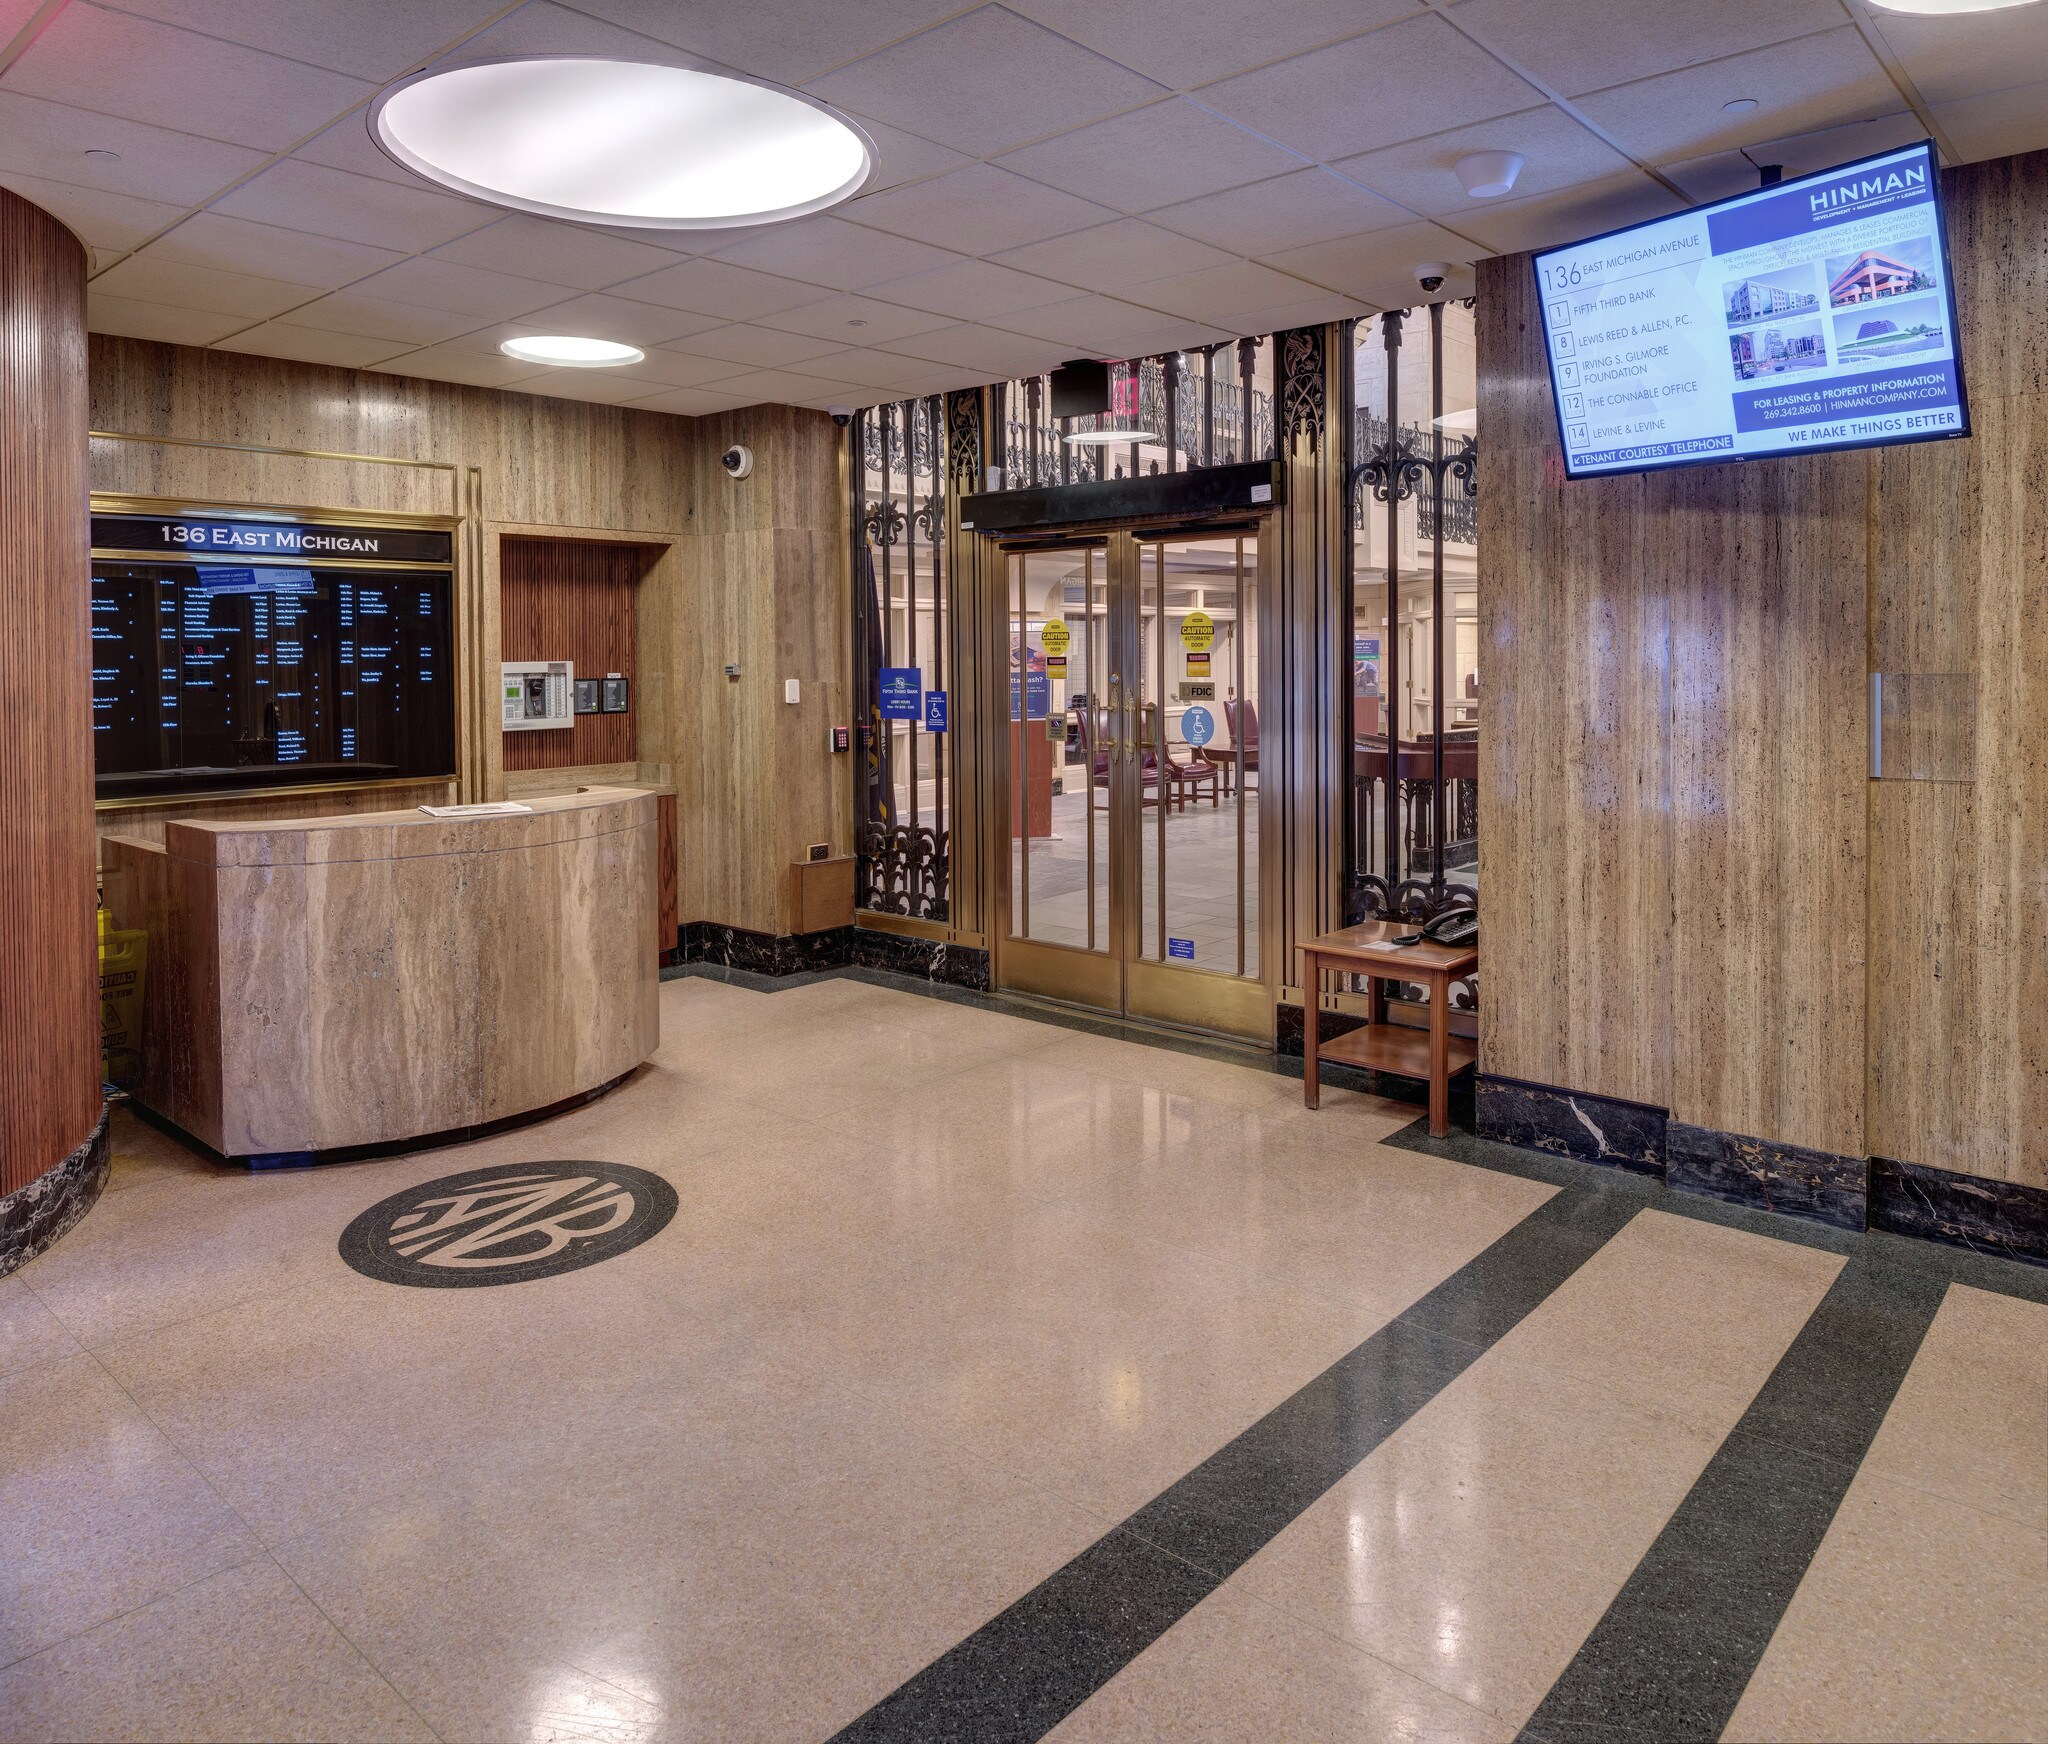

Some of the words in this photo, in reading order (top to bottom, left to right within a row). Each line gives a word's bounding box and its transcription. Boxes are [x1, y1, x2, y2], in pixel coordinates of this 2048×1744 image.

[1809, 165, 1926, 212] HINMAN
[1813, 208, 1851, 222] DEVELOPMENT
[1856, 197, 1895, 211] MANAGEMENT
[1901, 188, 1926, 199] LEASING
[1723, 256, 1733, 265] THE
[1733, 250, 1758, 262] HINMAN
[1759, 243, 1788, 256] COMPANY
[1821, 227, 1852, 240] MANAGES
[1859, 220, 1881, 232] LEASES
[1882, 208, 1929, 225] COMMERCIAL
[1727, 262, 1745, 272] SPACE
[1788, 248, 1800, 256] THE
[1800, 241, 1828, 254] MIDWEST
[1829, 238, 1846, 248] WITH
[1852, 230, 1878, 241] DIVERSE
[1879, 220, 1917, 234] PORTFOLIO
[1786, 256, 1805, 266] RETAIL
[1853, 237, 1892, 250] RESIDENTIAL
[1892, 226, 1929, 241] BUILDINGS
[1544, 262, 1582, 291] 136
[1582, 261, 1604, 275] EAST
[1606, 246, 1657, 268] MICHIGAN
[1660, 234, 1700, 254] AVENUE
[1555, 306, 1562, 318] 1
[1573, 301, 1598, 316] FIFTH
[1599, 294, 1627, 311] THIRD
[1629, 287, 1657, 304] BANK
[1560, 336, 1568, 349] 8
[1578, 333, 1604, 347] LEWIS
[1606, 327, 1629, 341] REED
[1631, 325, 1638, 336] &
[1640, 318, 1673, 335] ALLEN,
[1675, 314, 1693, 327] P.C.
[1582, 356, 1613, 371] IRVING
[1615, 353, 1623, 365] S.
[1625, 344, 1670, 363] GILMORE
[1564, 367, 1572, 379] 9
[1584, 364, 1648, 385] FOUNDATION
[1566, 397, 1580, 410] 12
[1587, 397, 1605, 409] THE
[1607, 387, 1659, 405] CONNABLE
[1662, 380, 1698, 396] OFFICE
[1753, 398, 1772, 410] FOR
[1773, 392, 1812, 407] LEASING
[1813, 391, 1821, 401] &
[1822, 384, 1869, 400] PROPERTY
[1871, 373, 1946, 393] INFORMATION
[1763, 403, 1822, 420] 269.342.8600
[1830, 386, 1947, 411] HINMANCOMPANY.COM
[1571, 427, 1585, 439] 14
[1592, 425, 1622, 439] LEVINE
[1625, 424, 1632, 434] &
[1635, 419, 1666, 433] LEVINE
[1788, 431, 1808, 443] WE
[1810, 426, 1847, 441] MAKE
[1849, 418, 1902, 436] THINGS
[1906, 412, 1956, 429] BETTER
[1580, 451, 1616, 465] TENANT
[1619, 444, 1670, 461] COURTESY
[1671, 436, 1731, 454] TELEPHONE
[161, 525, 206, 543] 136
[212, 528, 270, 546] EAST
[276, 532, 379, 553] MICHIGAN
[1042, 632, 1069, 640] CAUTION
[1181, 626, 1214, 634] CAUTION
[1191, 687, 1212, 696] FDIC
